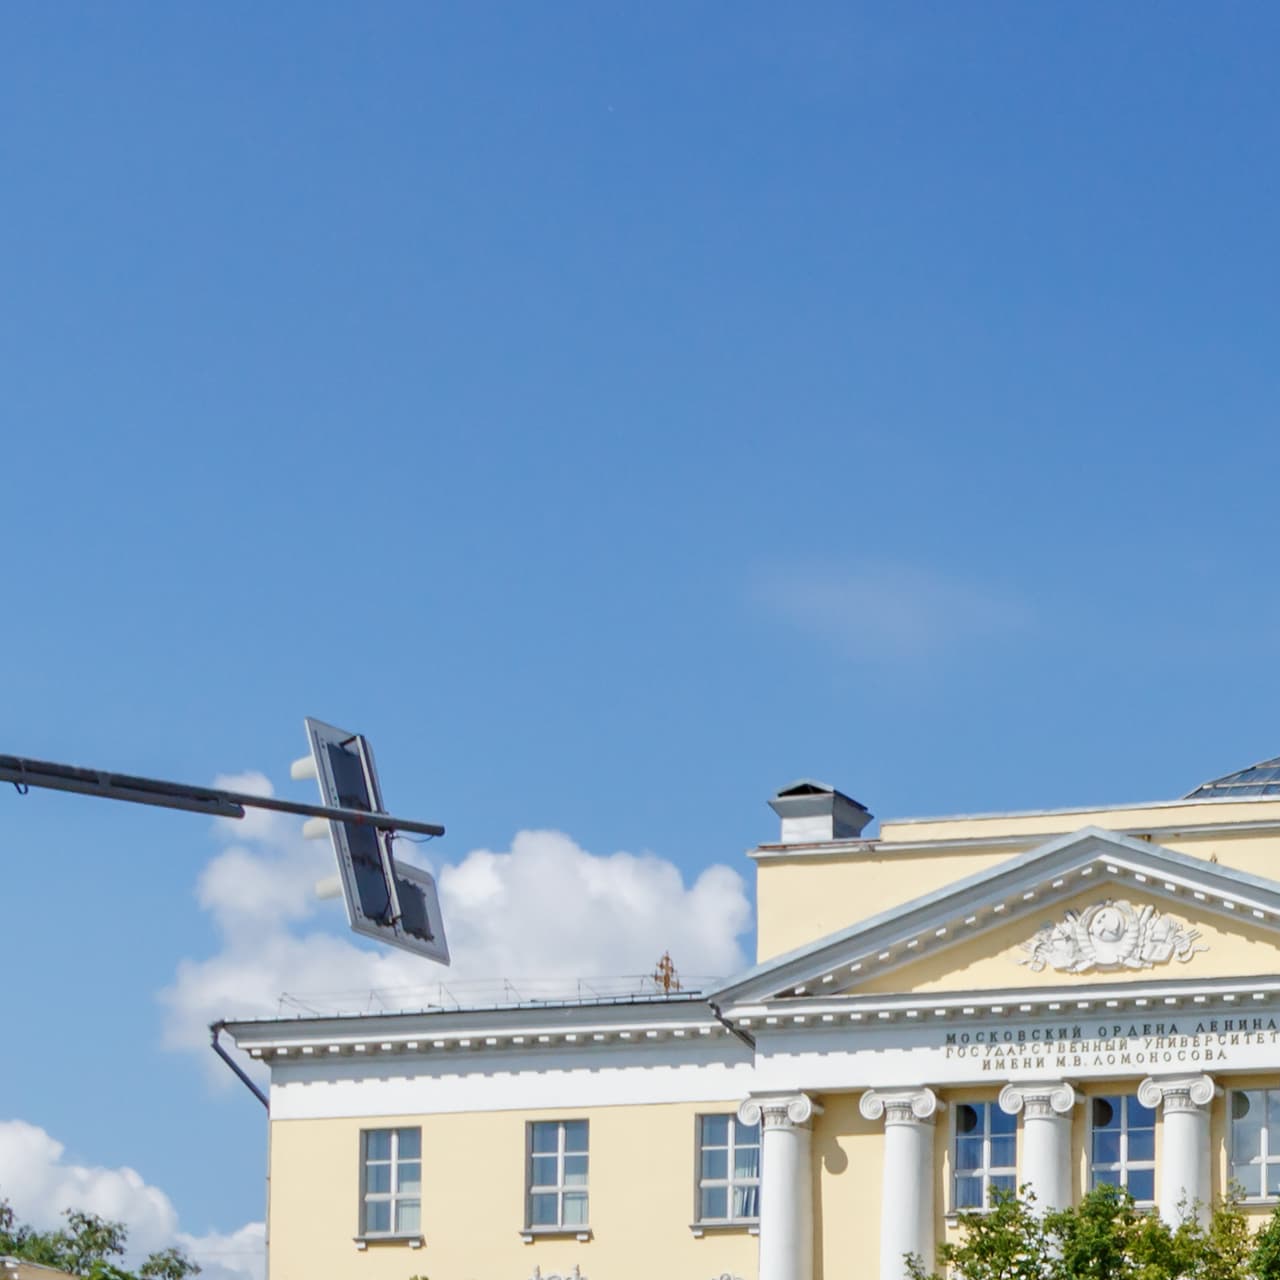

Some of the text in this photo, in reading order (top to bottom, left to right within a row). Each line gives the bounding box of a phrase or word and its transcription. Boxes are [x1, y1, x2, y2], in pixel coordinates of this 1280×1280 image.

[945, 1031, 1280, 1059] ГОСУДАРСТВЕННЫЙ УНИВЕРСИТЕТ
[946, 1018, 1278, 1045] МОСКОВСКИЙ ОРДЕНА ЛЕНИНА
[982, 1049, 1228, 1071] ИМЕНИ М.В. ЛОМОНОСОВА
